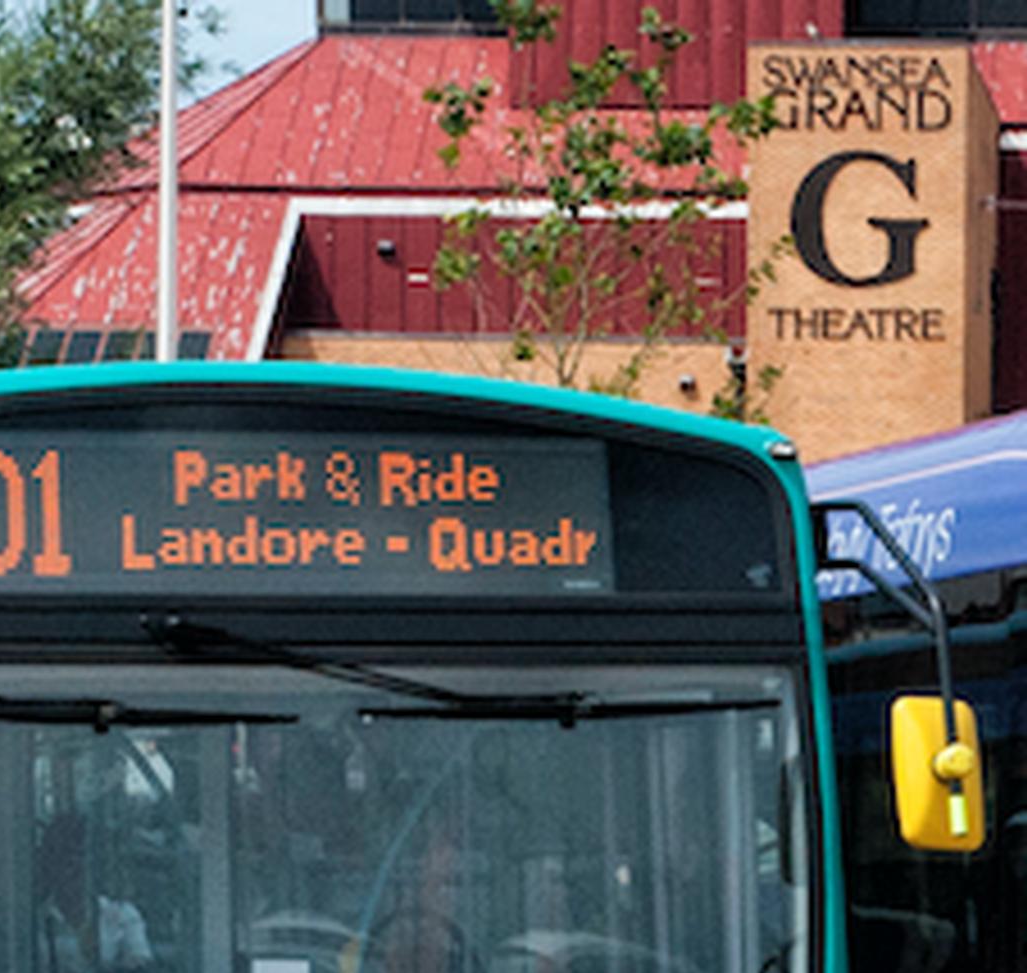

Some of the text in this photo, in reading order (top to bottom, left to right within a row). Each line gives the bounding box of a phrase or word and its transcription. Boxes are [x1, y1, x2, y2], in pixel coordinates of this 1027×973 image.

[762, 54, 951, 89] SWANSEA
[772, 87, 953, 132] GRAND
[790, 150, 930, 288] G
[768, 307, 946, 342] THEATRE
[175, 451, 499, 507] Park & Ride
[122, 515, 365, 571] Landore
[429, 516, 597, 573] Quadr
